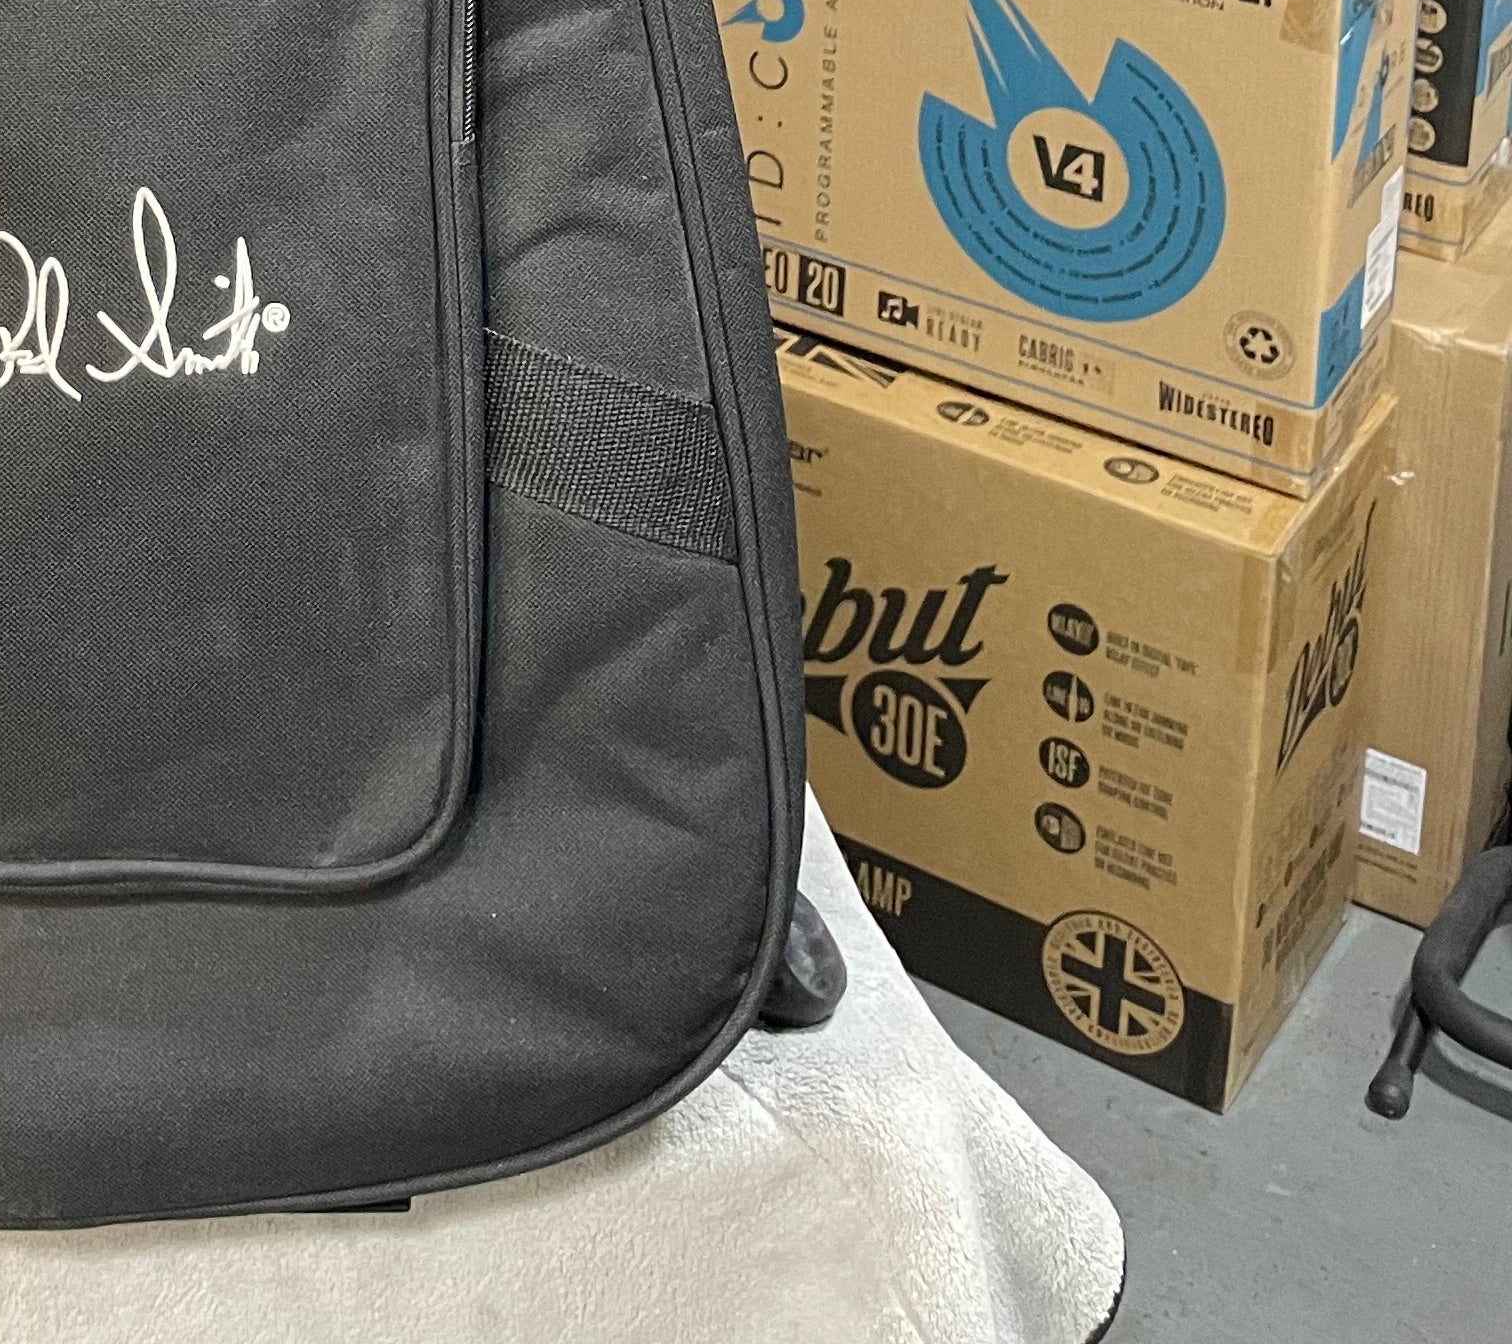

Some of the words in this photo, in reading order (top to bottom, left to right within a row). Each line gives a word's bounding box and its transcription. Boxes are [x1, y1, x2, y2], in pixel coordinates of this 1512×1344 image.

[814, 24, 838, 243] PROGRAMMABLE
[1033, 134, 1105, 202] V4
[806, 261, 839, 310] 20
[1159, 380, 1275, 447] WIDESTEREO
[801, 556, 1011, 666] but
[870, 684, 948, 778] 30E
[1048, 741, 1082, 783] ISF
[856, 862, 913, 917] AMP
